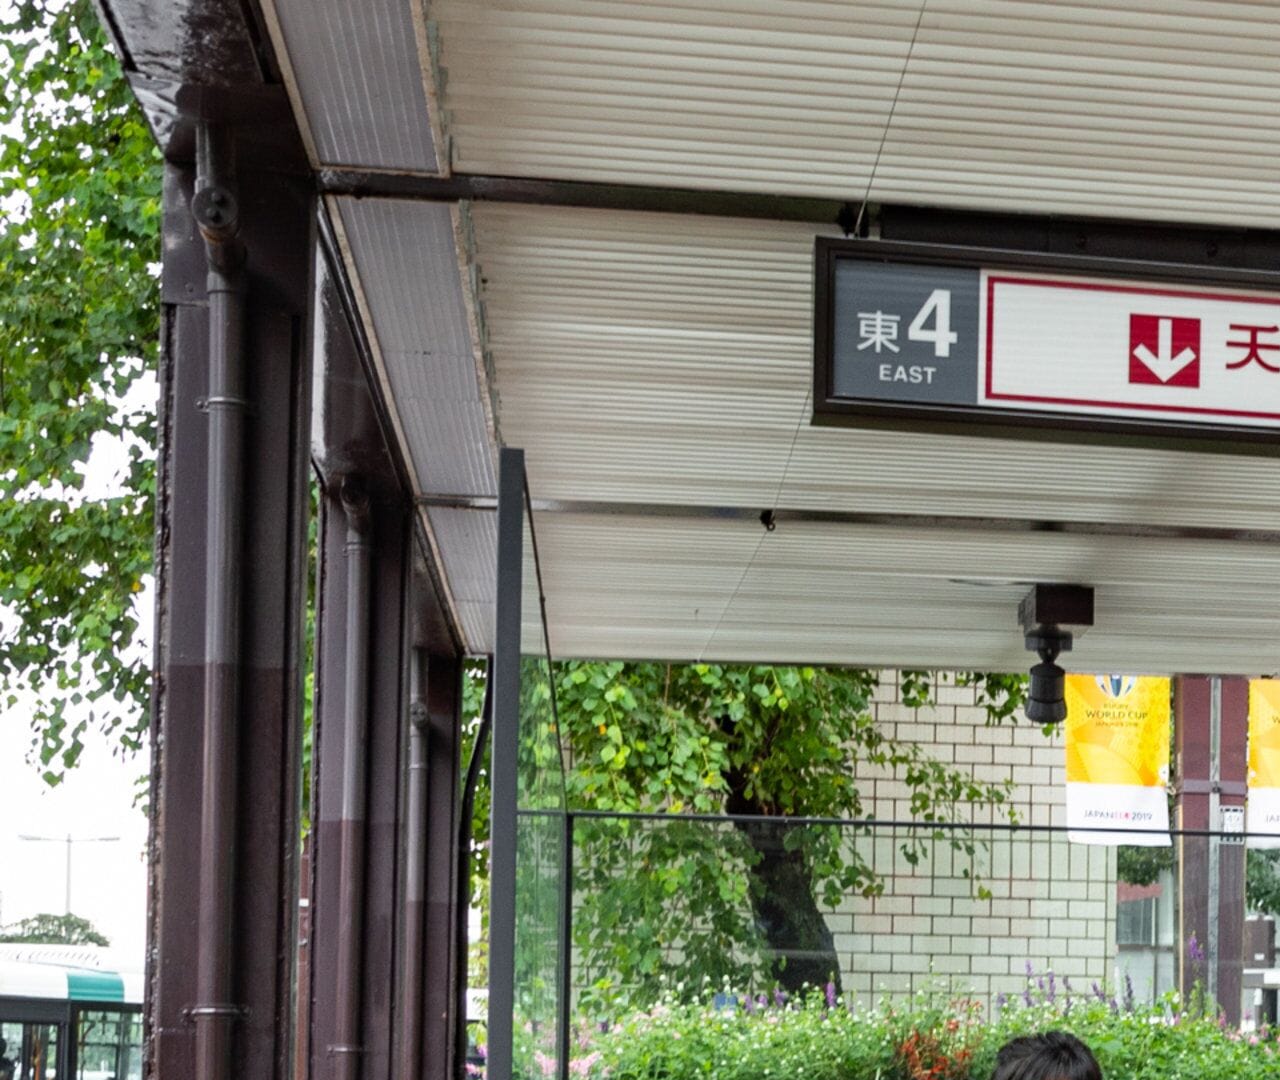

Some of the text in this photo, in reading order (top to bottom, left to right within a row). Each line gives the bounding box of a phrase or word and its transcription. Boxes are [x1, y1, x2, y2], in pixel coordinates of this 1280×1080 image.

[878, 363, 936, 385] EAST
[1086, 710, 1148, 719] WORLD CUP
